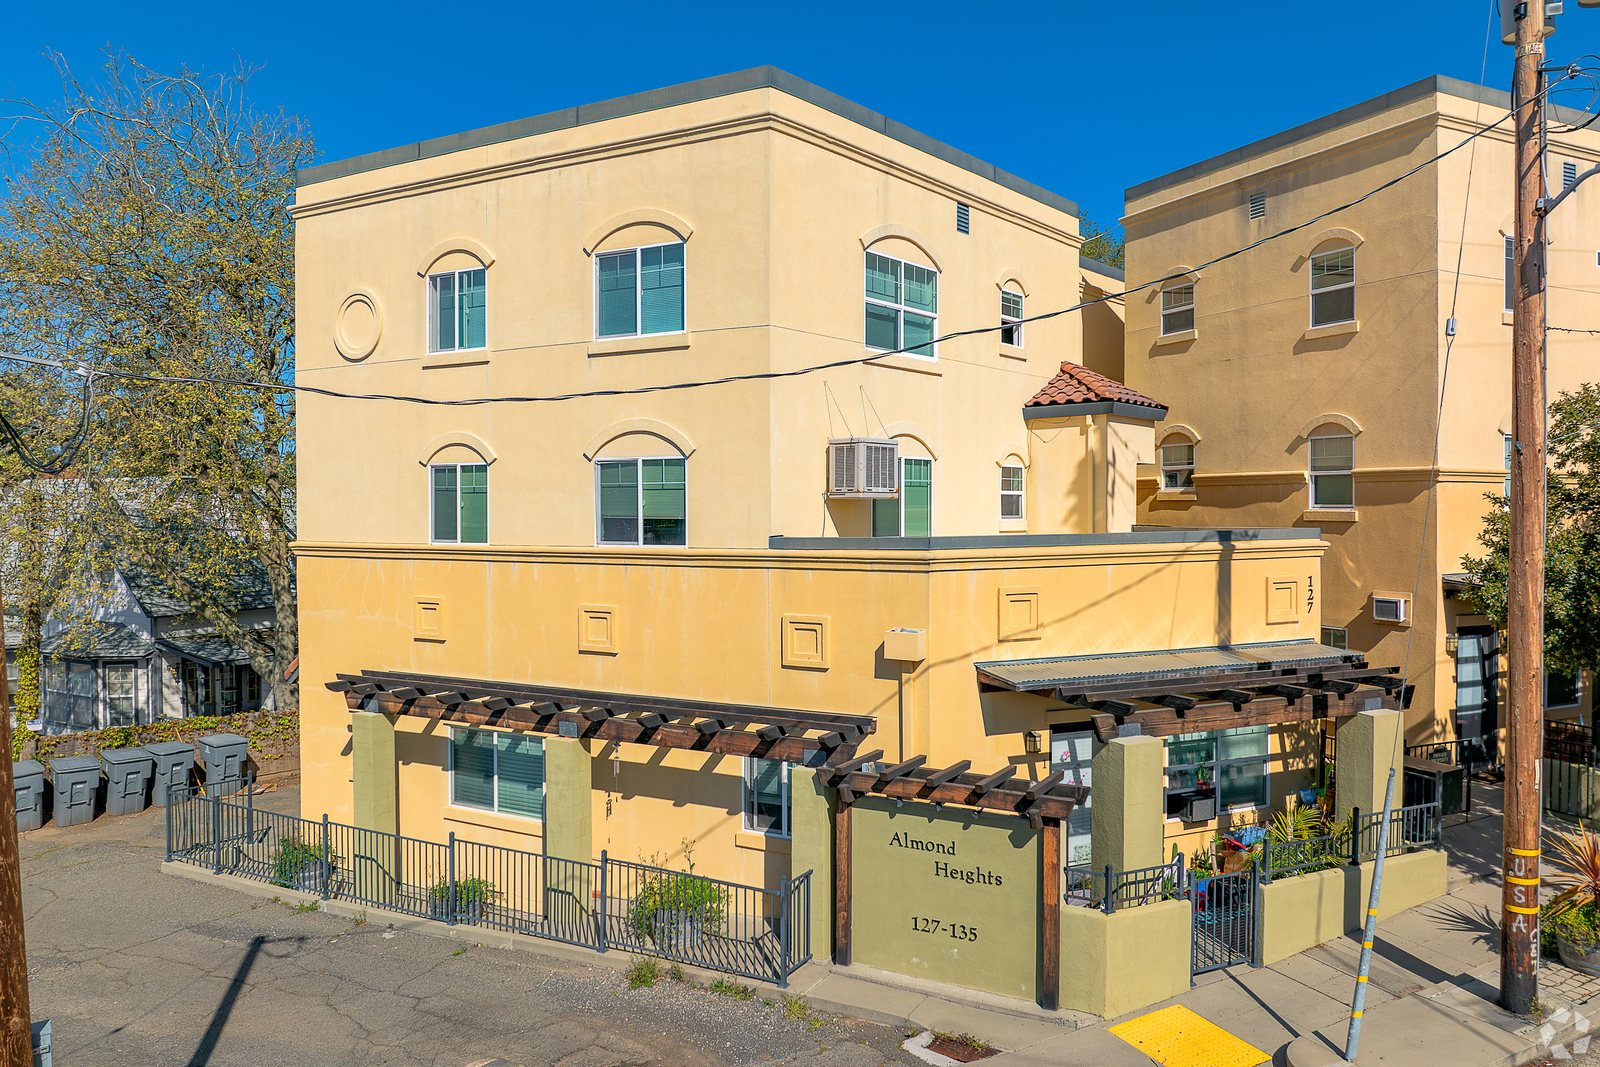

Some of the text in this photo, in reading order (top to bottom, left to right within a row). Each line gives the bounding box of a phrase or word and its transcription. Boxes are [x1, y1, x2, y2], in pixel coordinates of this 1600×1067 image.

[888, 831, 956, 856] Almond
[934, 861, 1003, 886] Heights
[911, 916, 978, 942] 127-135
